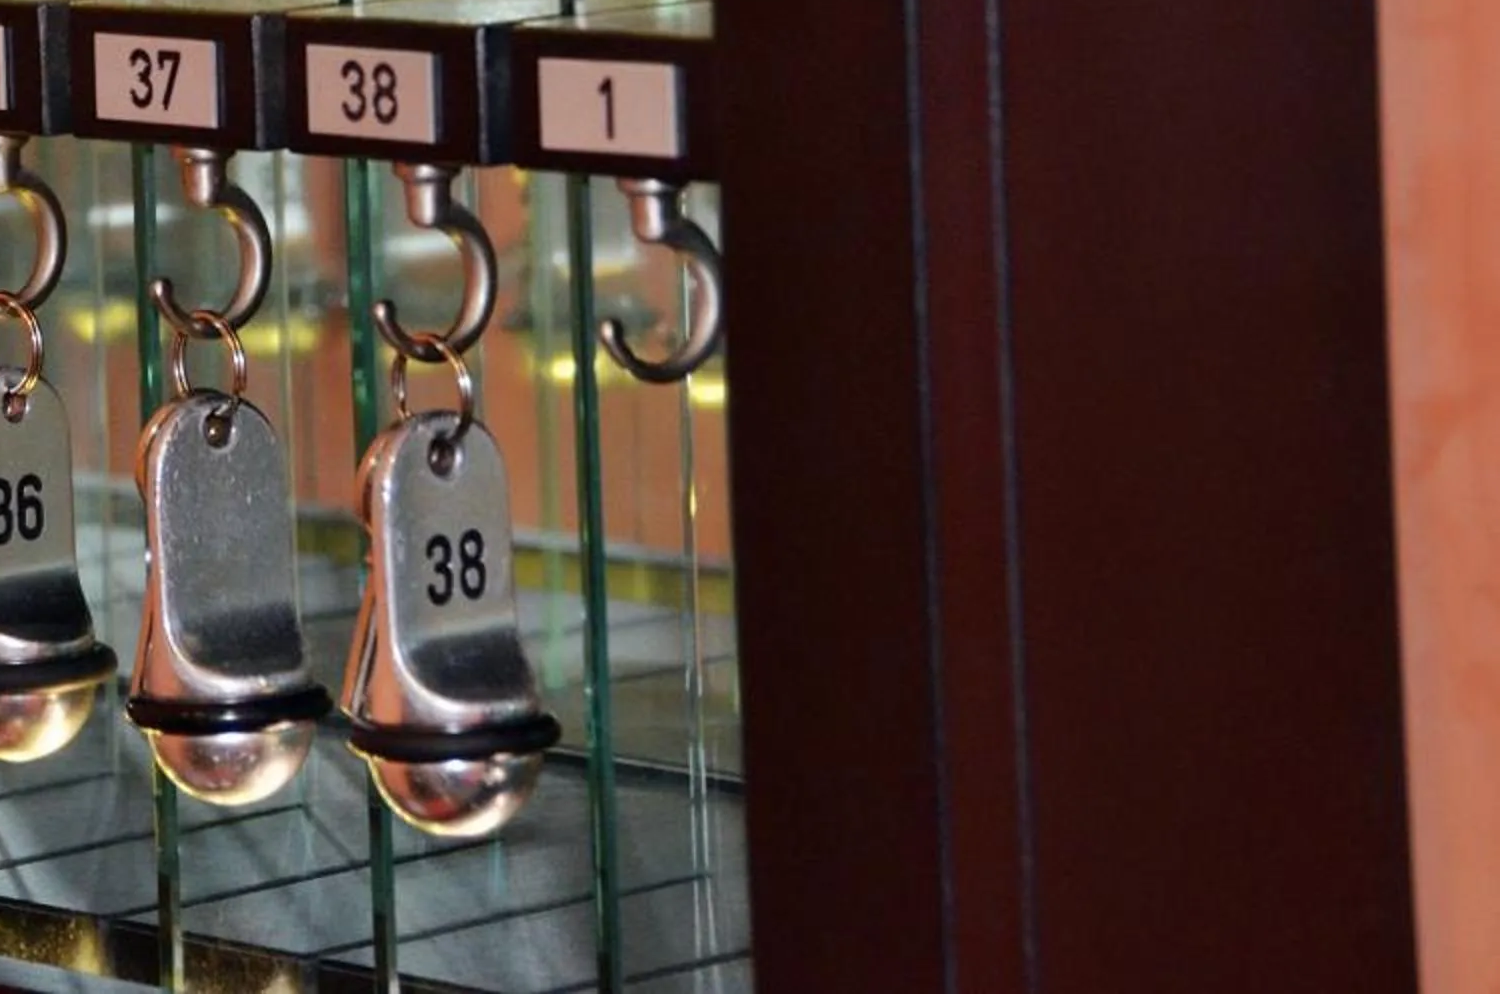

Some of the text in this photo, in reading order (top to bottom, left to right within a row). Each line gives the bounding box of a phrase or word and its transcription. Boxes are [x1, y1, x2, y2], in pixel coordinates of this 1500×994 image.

[129, 48, 181, 111] 37
[340, 59, 398, 125] 38
[597, 76, 615, 140] 1
[425, 528, 487, 607] 38
